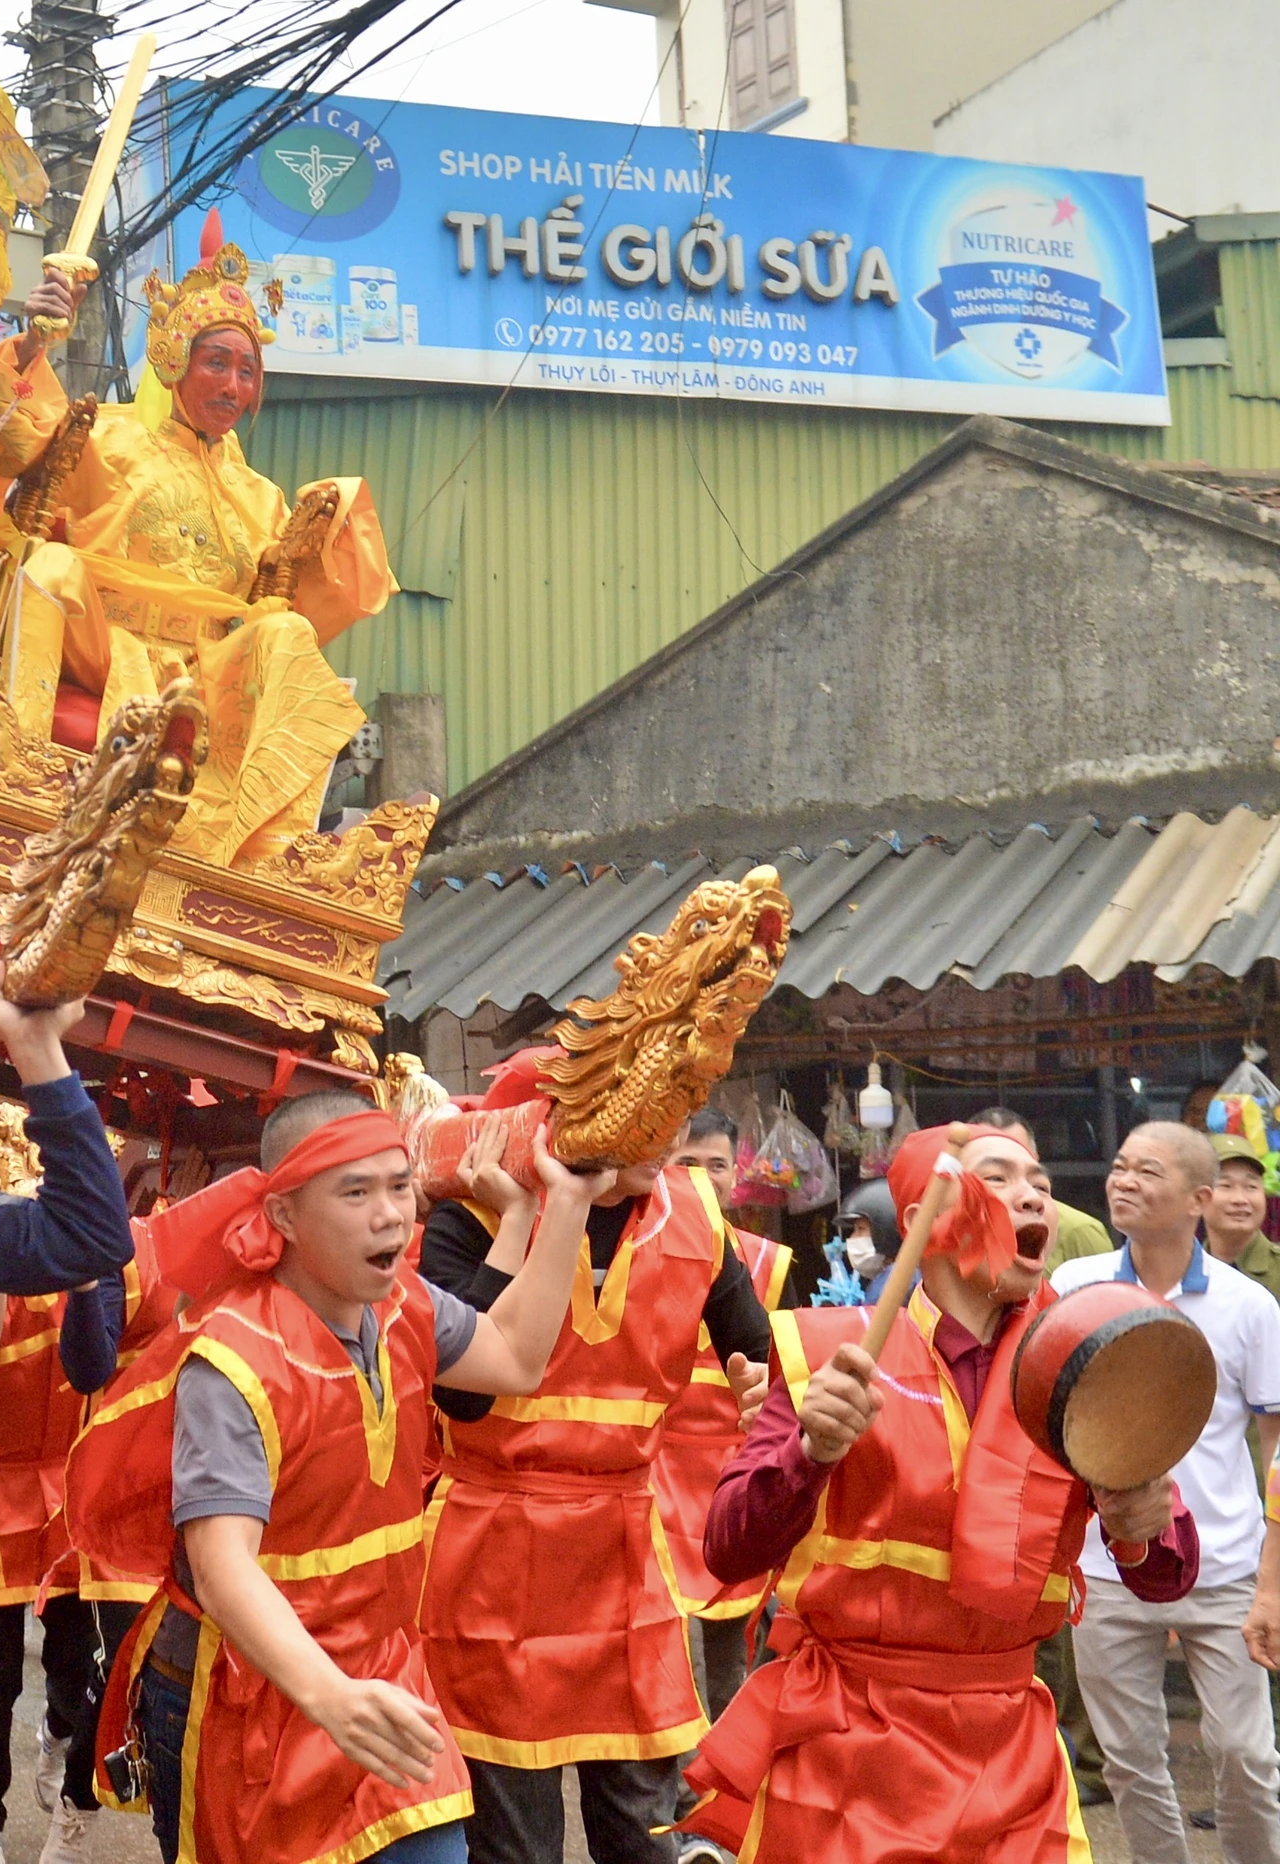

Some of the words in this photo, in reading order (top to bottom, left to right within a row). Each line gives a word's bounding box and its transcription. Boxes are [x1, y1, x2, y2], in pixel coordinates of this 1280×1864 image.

[439, 150, 522, 181] SHOP
[529, 152, 583, 187] HẢI
[589, 154, 656, 193] TIẾN
[444, 194, 588, 283] THẾ
[602, 212, 745, 293] GIỚI
[759, 230, 900, 307] SỮA
[962, 231, 1074, 258] NUTRICARE
[365, 300, 387, 311] 100
[545, 295, 581, 316] NƠI
[587, 299, 619, 322] MẸ
[624, 296, 662, 321] GỬI
[721, 302, 772, 329] NIỀM
[776, 312, 807, 332] TIN
[528, 324, 587, 349] 0977
[593, 328, 633, 352] 162
[639, 331, 685, 354] 205
[708, 334, 763, 360] 0979
[770, 340, 812, 364] 093
[817, 344, 858, 367] 047
[538, 363, 585, 383] THỤY
[632, 370, 679, 389] THỤY
[683, 369, 719, 388] LÂM
[734, 374, 784, 394] ĐÔNG
[789, 380, 825, 396] ANH
